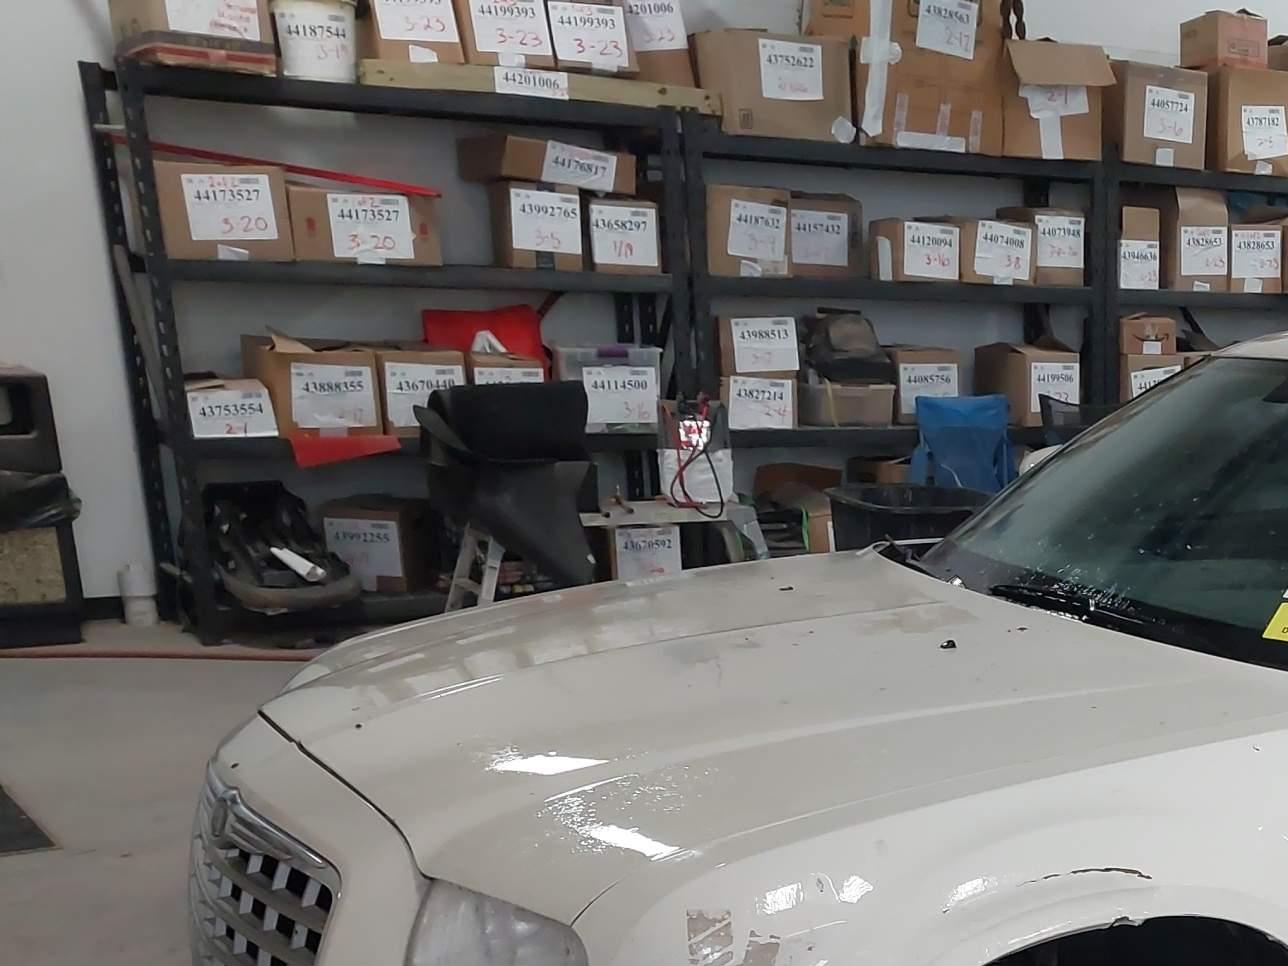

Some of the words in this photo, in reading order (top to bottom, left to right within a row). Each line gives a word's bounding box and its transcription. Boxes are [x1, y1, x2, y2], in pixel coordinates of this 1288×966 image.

[478, 5, 536, 19] 44199393
[626, 1, 673, 15] 4201006
[558, 15, 616, 30] 44199393
[285, 23, 346, 39] 44187544
[496, 28, 543, 48] 3-23
[574, 38, 624, 58] 3-23
[767, 54, 814, 69] 43752622
[503, 72, 560, 90] 44201006
[1246, 117, 1280, 129] 43787182
[552, 154, 607, 176] 44176817
[194, 189, 260, 201] 44173527
[337, 208, 400, 221] 44173527
[520, 202, 578, 219] 43992765
[222, 215, 268, 233] 3-20
[592, 218, 647, 233] 43658297
[736, 212, 780, 229] 44187632
[796, 223, 841, 235] 44157432
[1040, 226, 1081, 240] 44073948
[348, 234, 396, 250] 3-20
[910, 233, 953, 248] 44120094
[982, 234, 1024, 250] 44074008
[1236, 241, 1275, 253] 43828653
[739, 330, 789, 342] 43988513
[302, 379, 364, 392] 43888355
[397, 379, 456, 392] 43670440
[592, 380, 648, 391] 44114500
[907, 375, 952, 385] 44085756
[1037, 373, 1074, 384] 44199506
[736, 387, 784, 401] 43827214
[199, 403, 264, 417] 43753554
[623, 540, 672, 551] 43670592
